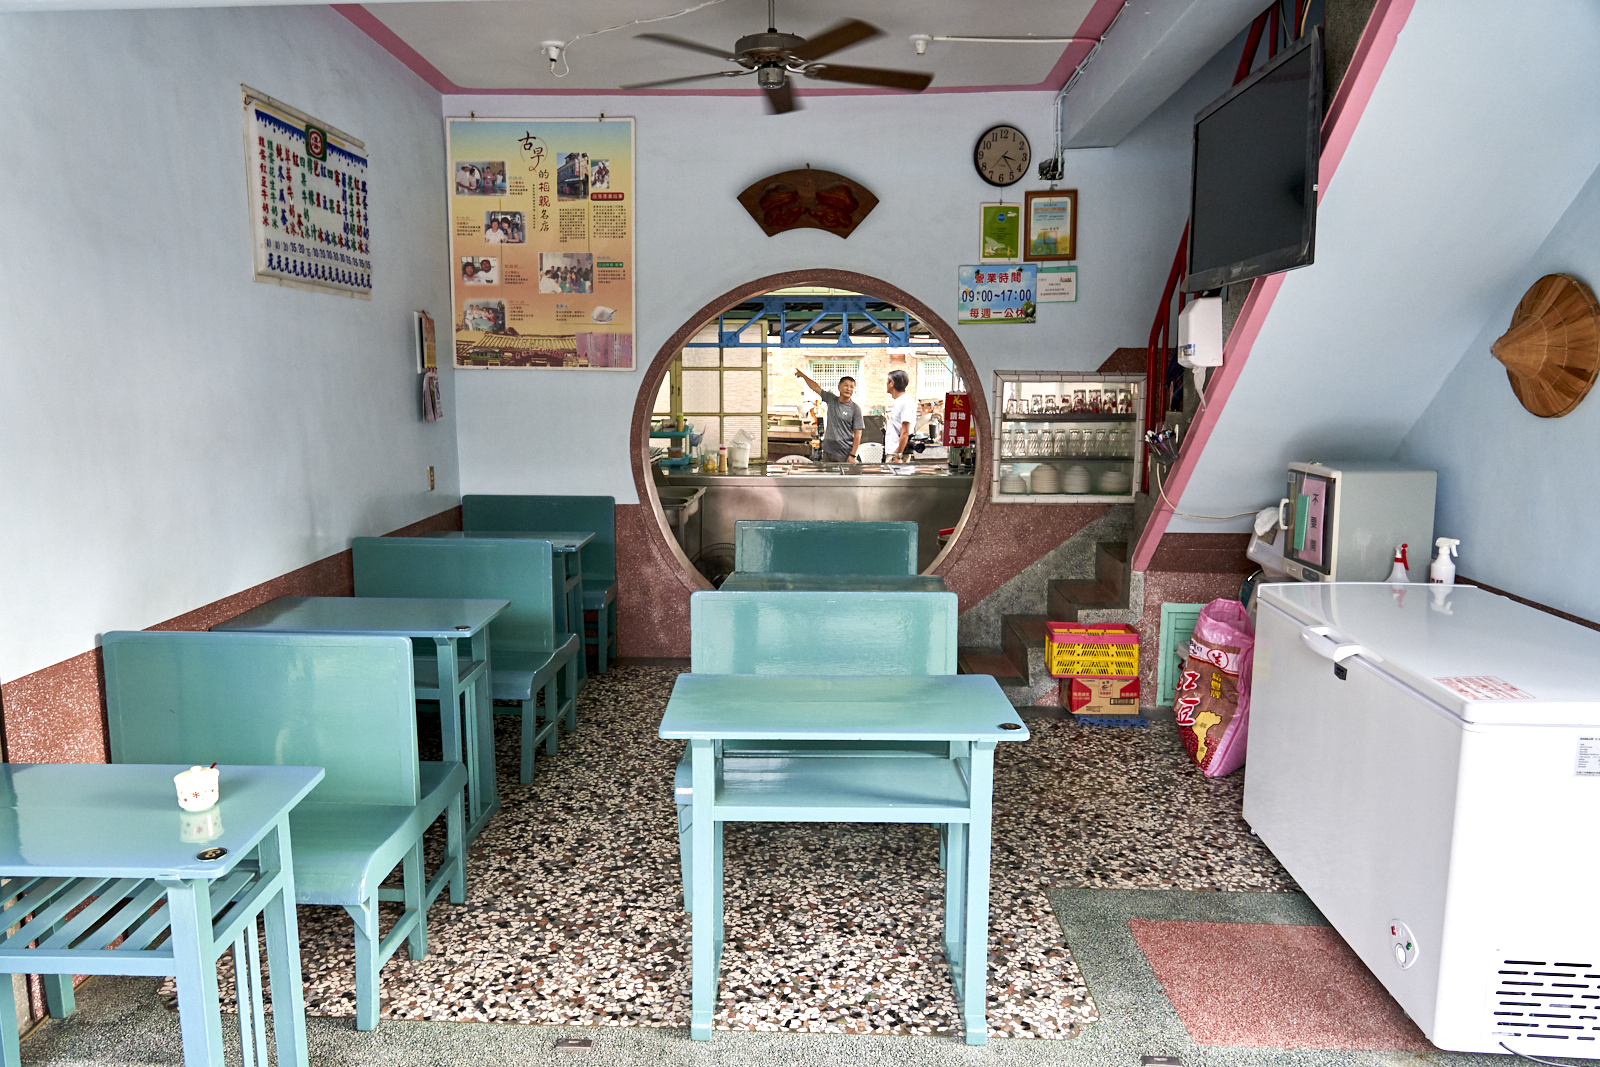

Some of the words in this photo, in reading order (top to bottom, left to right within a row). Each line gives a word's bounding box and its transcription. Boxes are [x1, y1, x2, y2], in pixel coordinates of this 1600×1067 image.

[992, 133, 997, 142] 11
[1000, 130, 1008, 138] 12
[1013, 133, 1015, 142] 1
[983, 141, 991, 150] 10
[1019, 141, 1024, 150] 2
[979, 151, 984, 159] 9
[1022, 153, 1027, 162] 3
[982, 162, 986, 171] 8
[1017, 163, 1022, 172] 4
[989, 171, 993, 179] 7
[999, 173, 1004, 182] 6
[1009, 172, 1014, 180] 5
[975, 272, 1021, 283] 營業時間
[962, 289, 1031, 302] 09:00~17:00
[970, 308, 1026, 318] 每週一公休
[949, 412, 958, 444] 請勿進入
